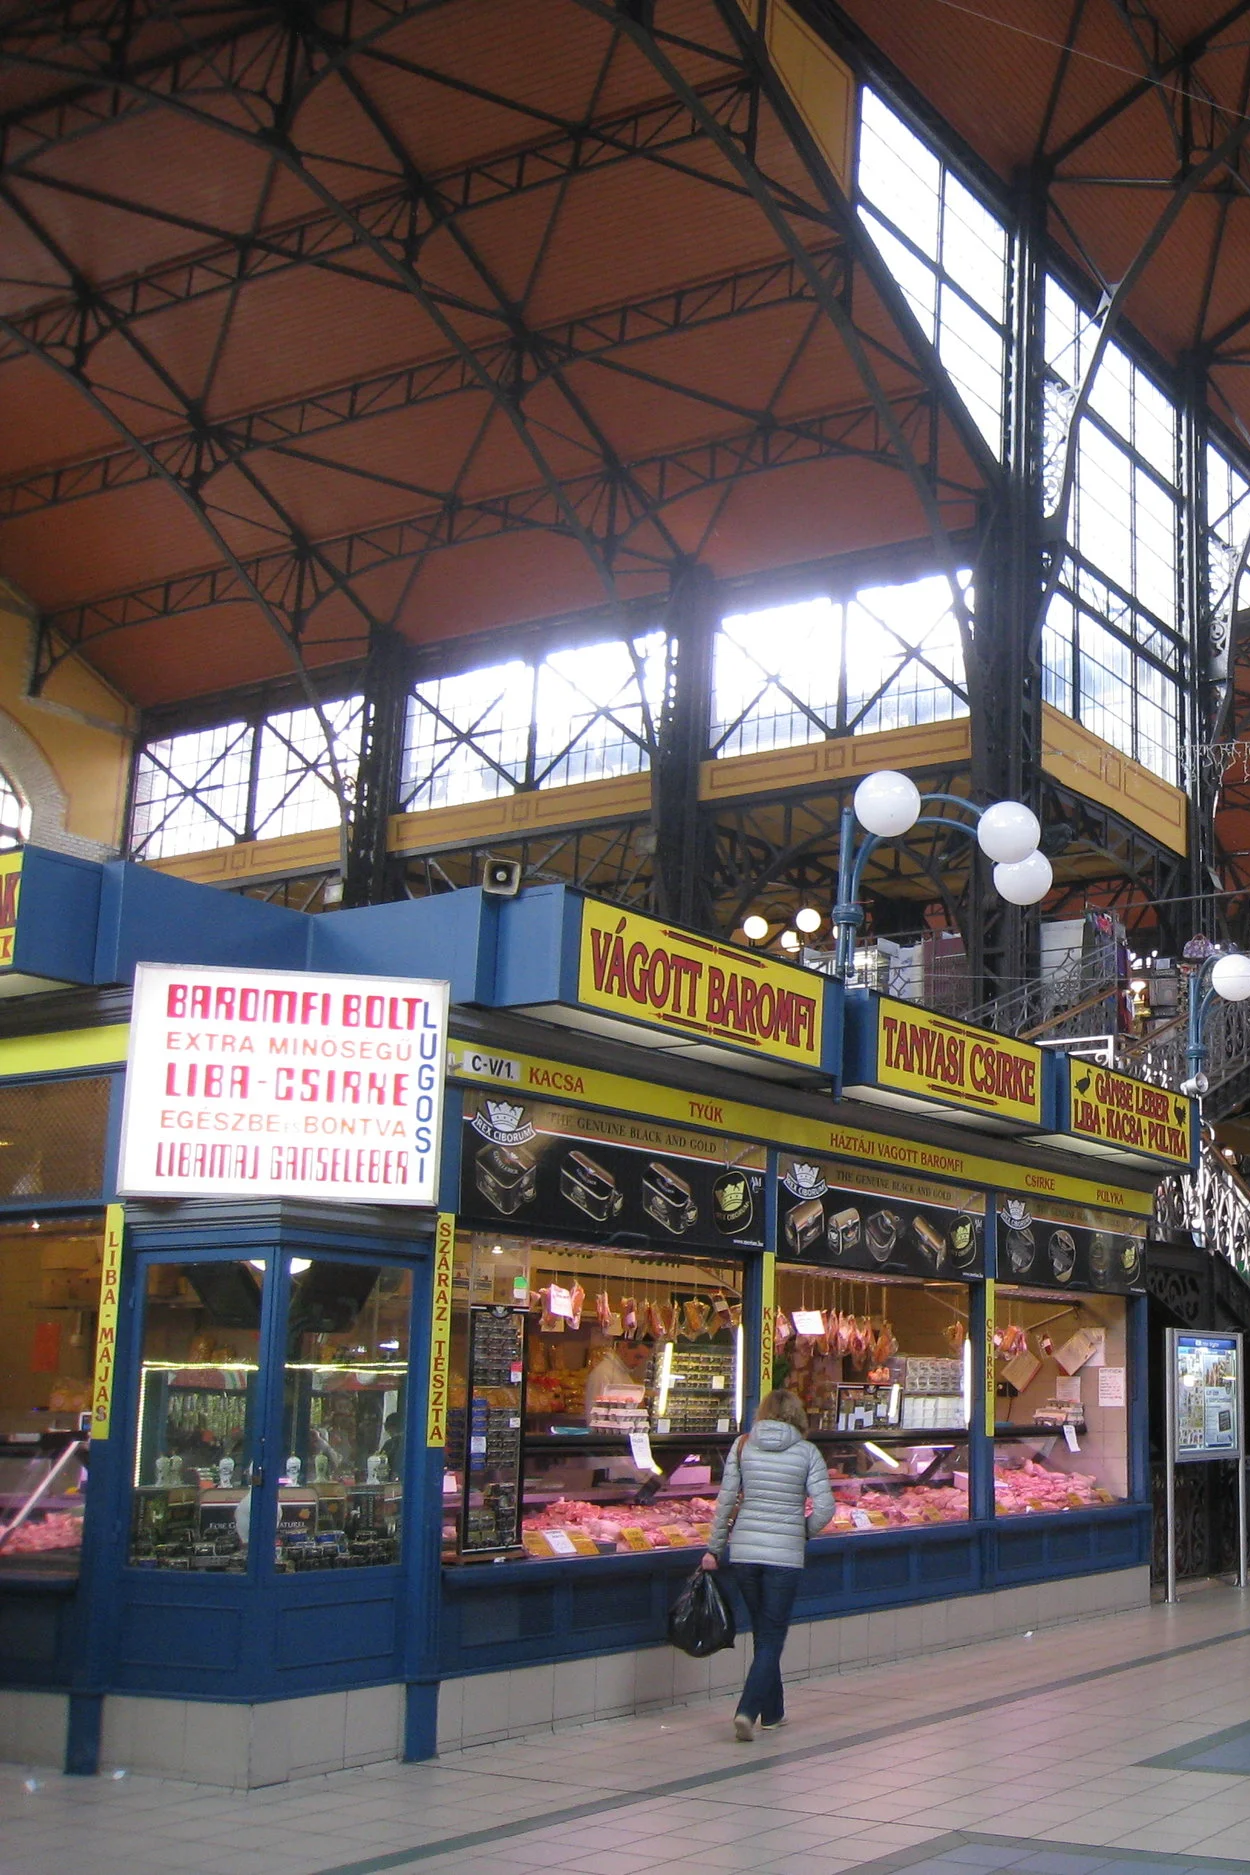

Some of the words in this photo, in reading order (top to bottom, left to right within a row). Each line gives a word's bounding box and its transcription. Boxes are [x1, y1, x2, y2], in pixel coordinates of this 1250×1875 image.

[590, 916, 702, 1017] VÁGOTT
[706, 966, 816, 1051] BAROMFI
[166, 984, 331, 1026] BAROMFI
[342, 994, 423, 1030] BOLT
[166, 1031, 254, 1053] EXTRA
[883, 1016, 965, 1087] TANYASI
[969, 1043, 1036, 1106] CSIRKE
[165, 1062, 250, 1099] LIBA
[275, 1067, 409, 1106] CSIRKE
[415, 1001, 437, 1183] LUGOSI
[471, 1056, 514, 1080] C-V/1.
[529, 1066, 585, 1094] KACSA
[688, 1100, 723, 1124] TYÚK
[1135, 1086, 1170, 1123] LEBER
[160, 1106, 281, 1132] EGÉSZBE
[303, 1115, 407, 1137] BONTVA
[476, 1118, 492, 1136] REX
[493, 1127, 533, 1143] CIBORUM
[577, 1117, 627, 1135] GENUINE
[630, 1127, 662, 1143] BLACK
[665, 1133, 687, 1147] AND
[690, 1138, 717, 1154] GOLD
[1074, 1098, 1102, 1135] LIBA
[1106, 1108, 1144, 1147] KACSA
[1148, 1121, 1188, 1159] PULYKA
[830, 1130, 875, 1154] HÁZTÁJI
[920, 1152, 963, 1173] BAROMFI
[836, 1169, 853, 1181] THE
[856, 1174, 889, 1188] GENUINE
[892, 1180, 914, 1193] BLACK
[917, 1186, 931, 1196] AND
[933, 1189, 952, 1201] GOLD
[1024, 1174, 1056, 1191] CSIRKE
[1096, 1189, 1124, 1205] PULYKA
[762, 1307, 771, 1380] KACSA
[985, 1318, 994, 1394] CSIRKE
